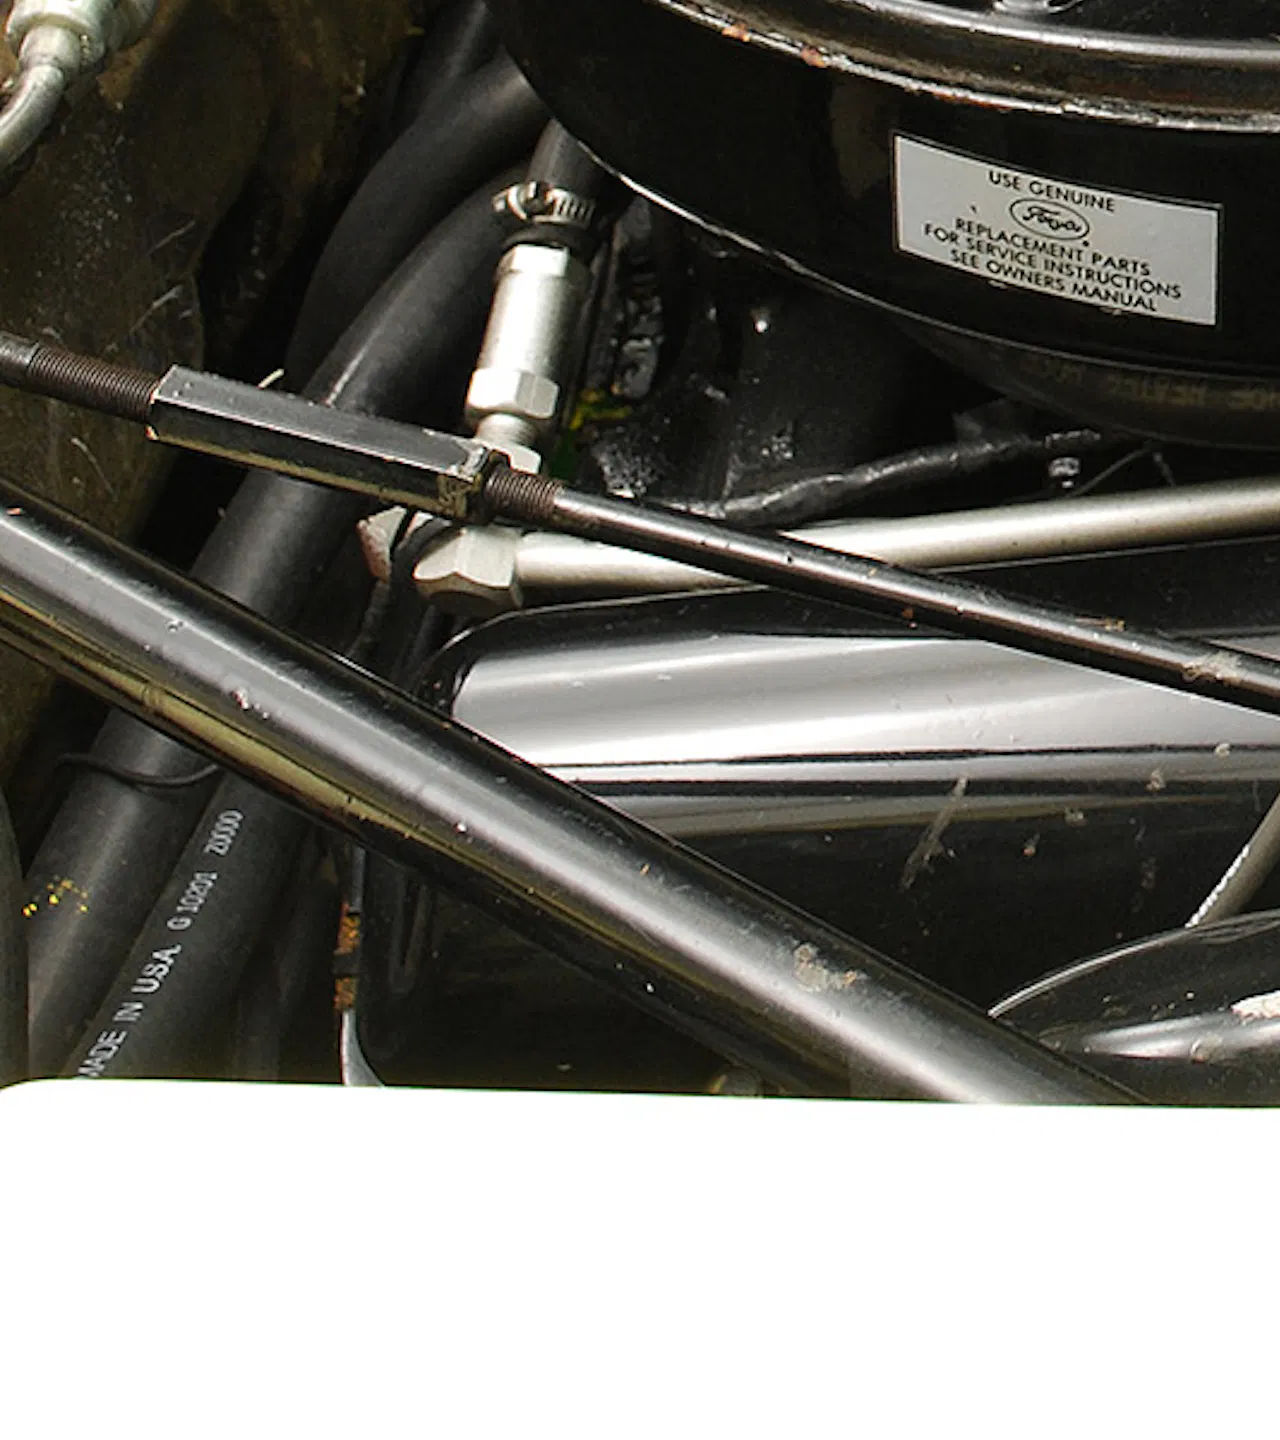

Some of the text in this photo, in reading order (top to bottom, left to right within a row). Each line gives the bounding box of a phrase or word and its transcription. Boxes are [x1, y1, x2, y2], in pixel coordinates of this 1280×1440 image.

[988, 170, 1116, 213] USE GENUINE
[924, 223, 1182, 300] FOR SERVICE INSTRUCTIONS
[955, 217, 1151, 277] REPLACEMENT PARTS
[950, 249, 1157, 312] SEE OWNERS MANUAL
[114, 1001, 144, 1022] IN
